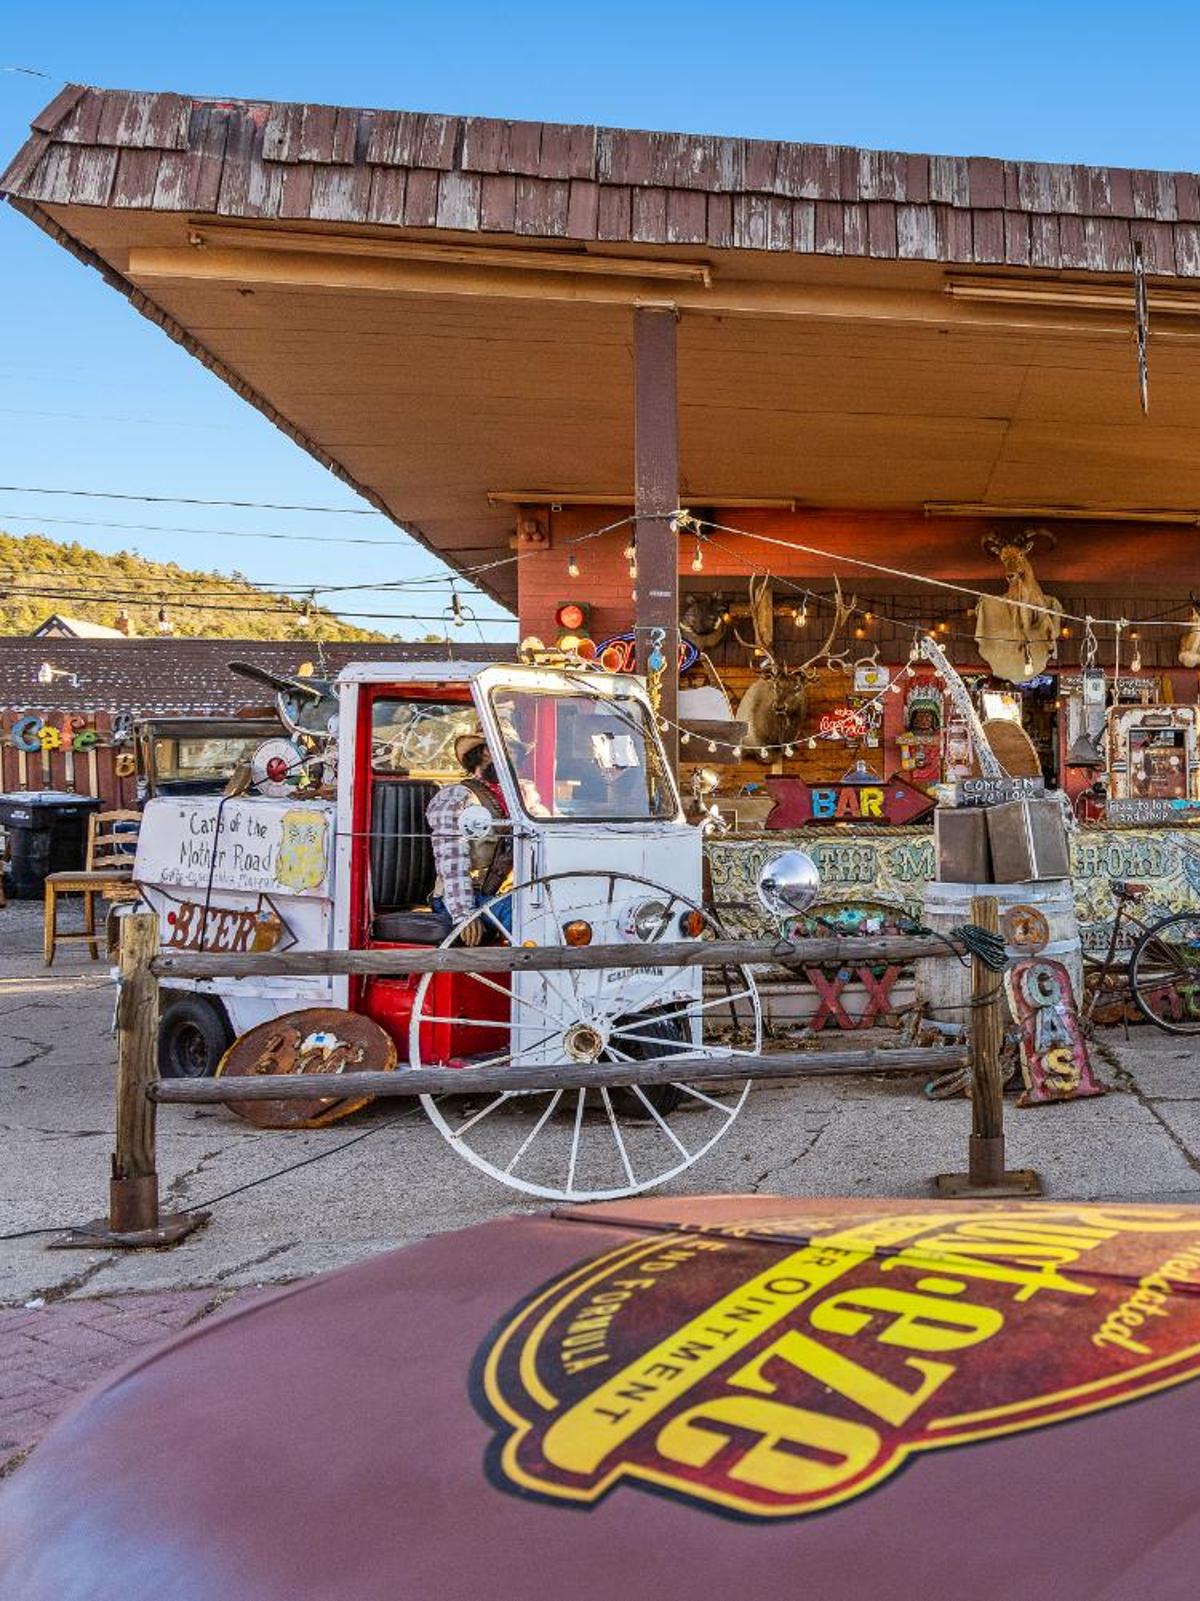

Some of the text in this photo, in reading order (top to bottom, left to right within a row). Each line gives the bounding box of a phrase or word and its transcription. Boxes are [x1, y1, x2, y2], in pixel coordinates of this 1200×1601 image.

[1012, 778, 1034, 790] IN
[811, 786, 885, 818] BAR
[189, 811, 268, 840] Cars of the
[180, 839, 272, 872] Mother Road
[169, 902, 259, 952] BEER
[592, 1276, 812, 1426] OINTMENT
